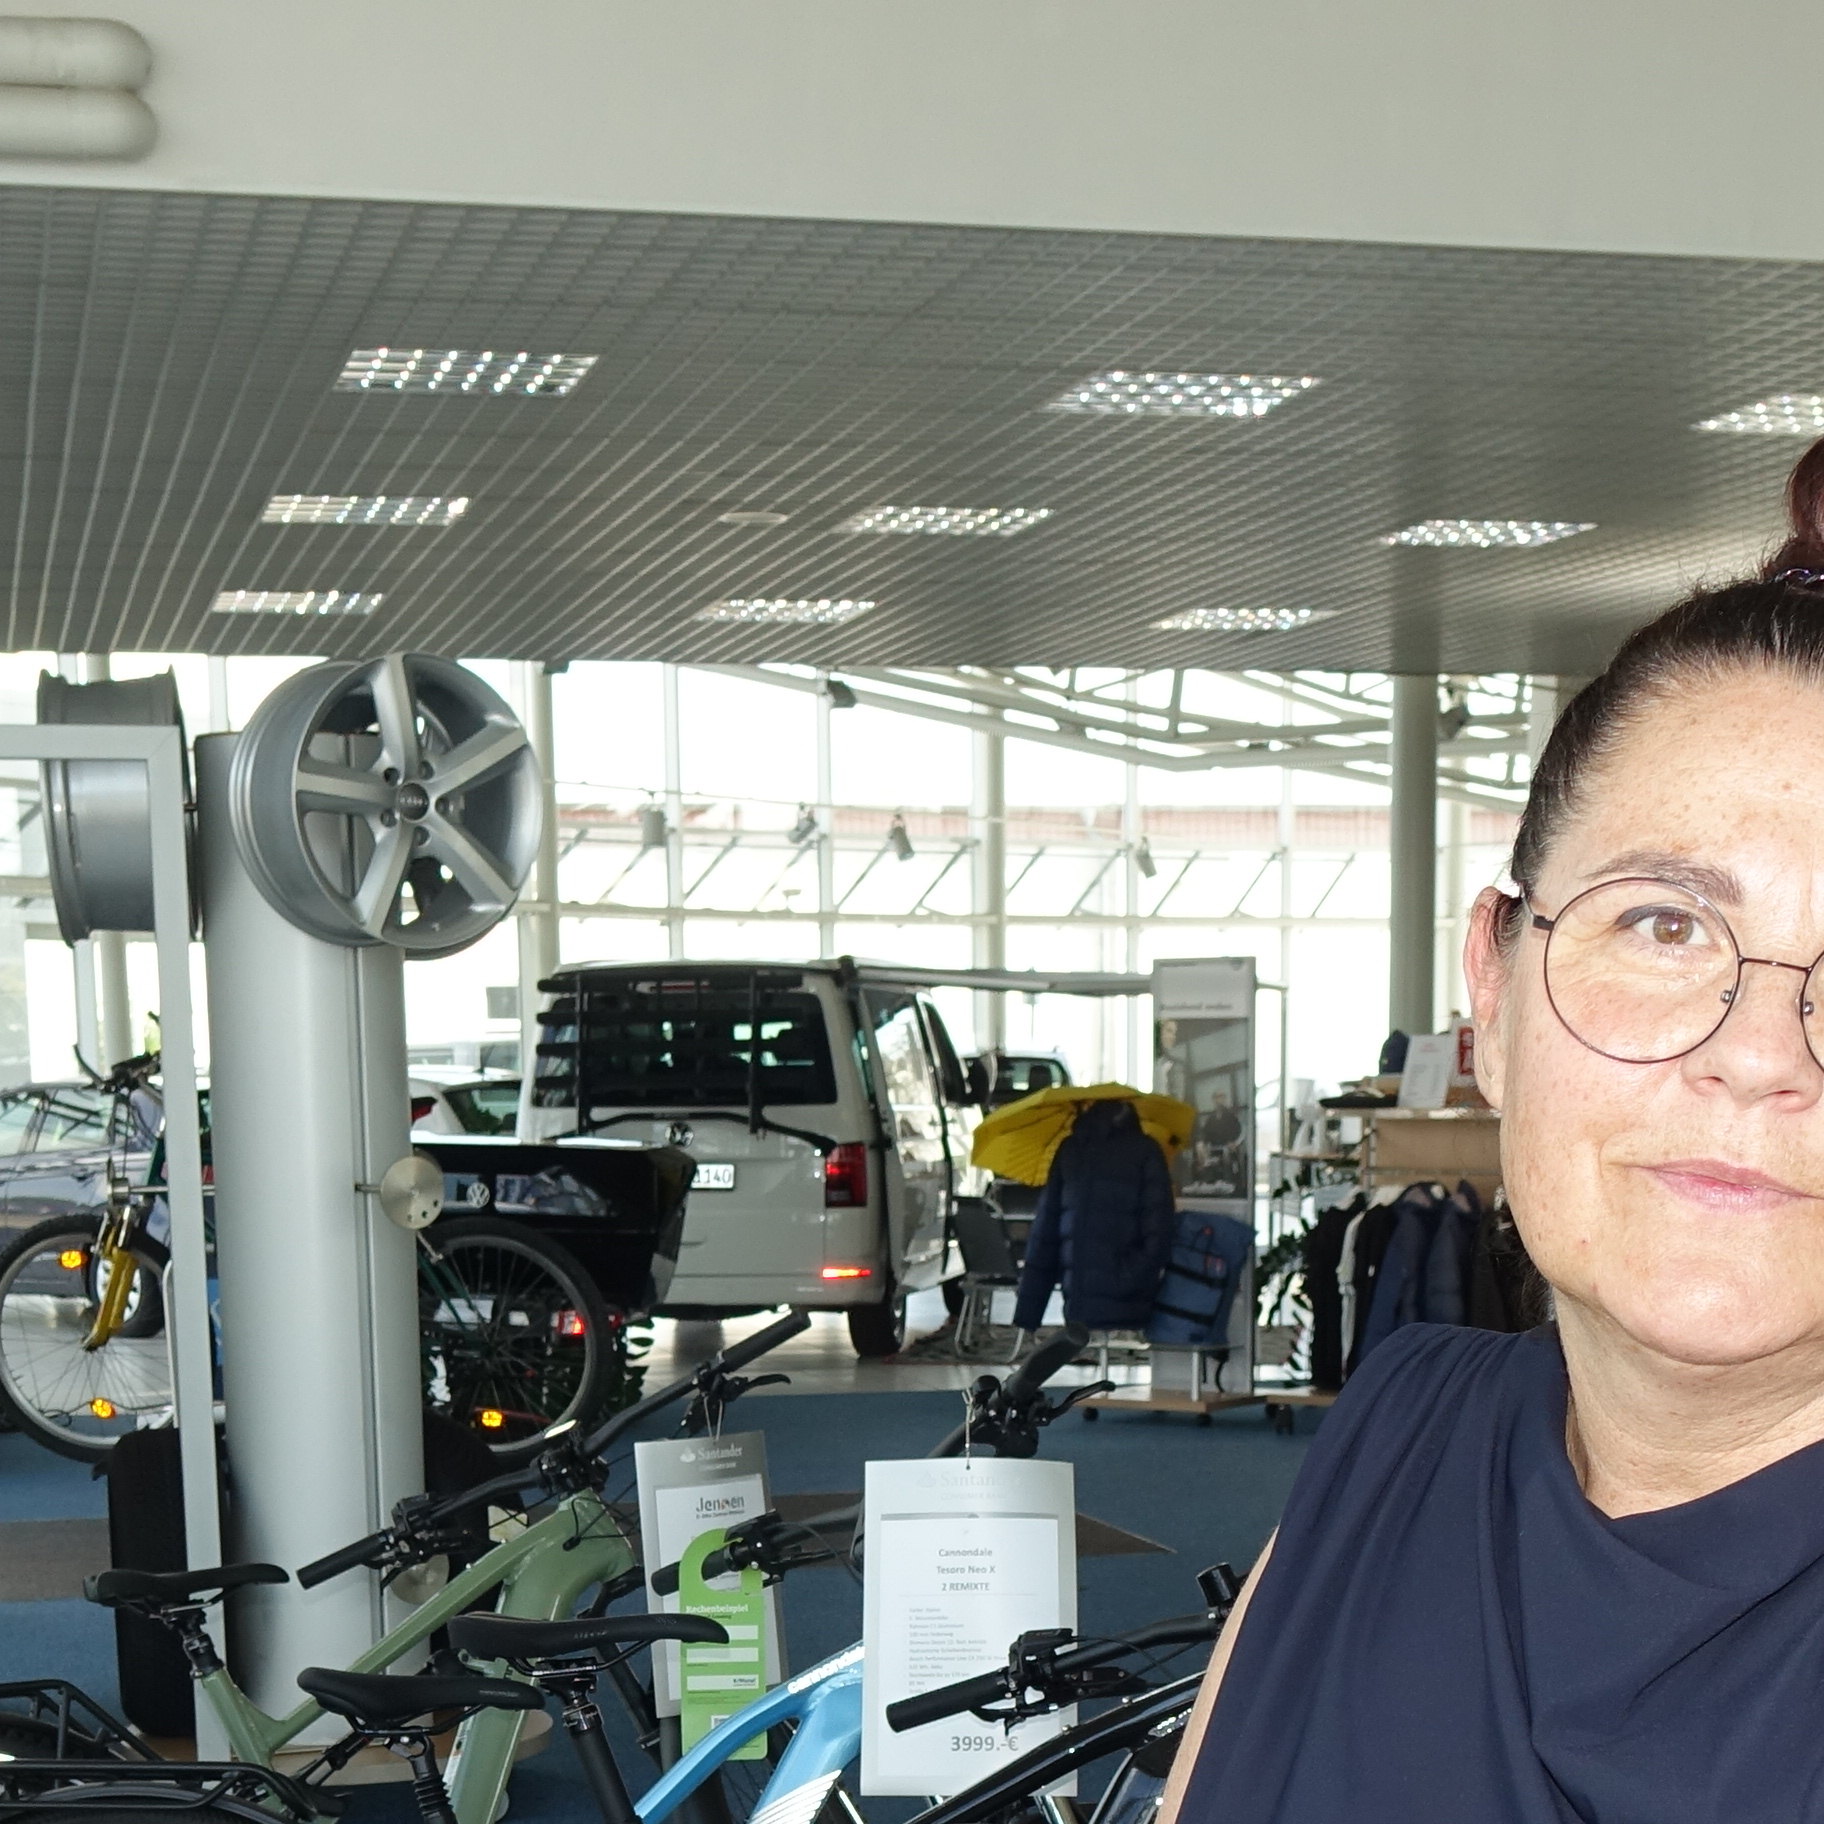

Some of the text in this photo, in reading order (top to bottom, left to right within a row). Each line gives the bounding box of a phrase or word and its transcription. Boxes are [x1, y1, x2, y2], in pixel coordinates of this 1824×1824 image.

[697, 1443, 743, 1461] Santander
[938, 1547, 993, 1557] Cannondale
[937, 1565, 996, 1574] Tesoro Neo X
[942, 1582, 991, 1591] 2 REMIXTE
[951, 1736, 1019, 1752] 3999.-€
